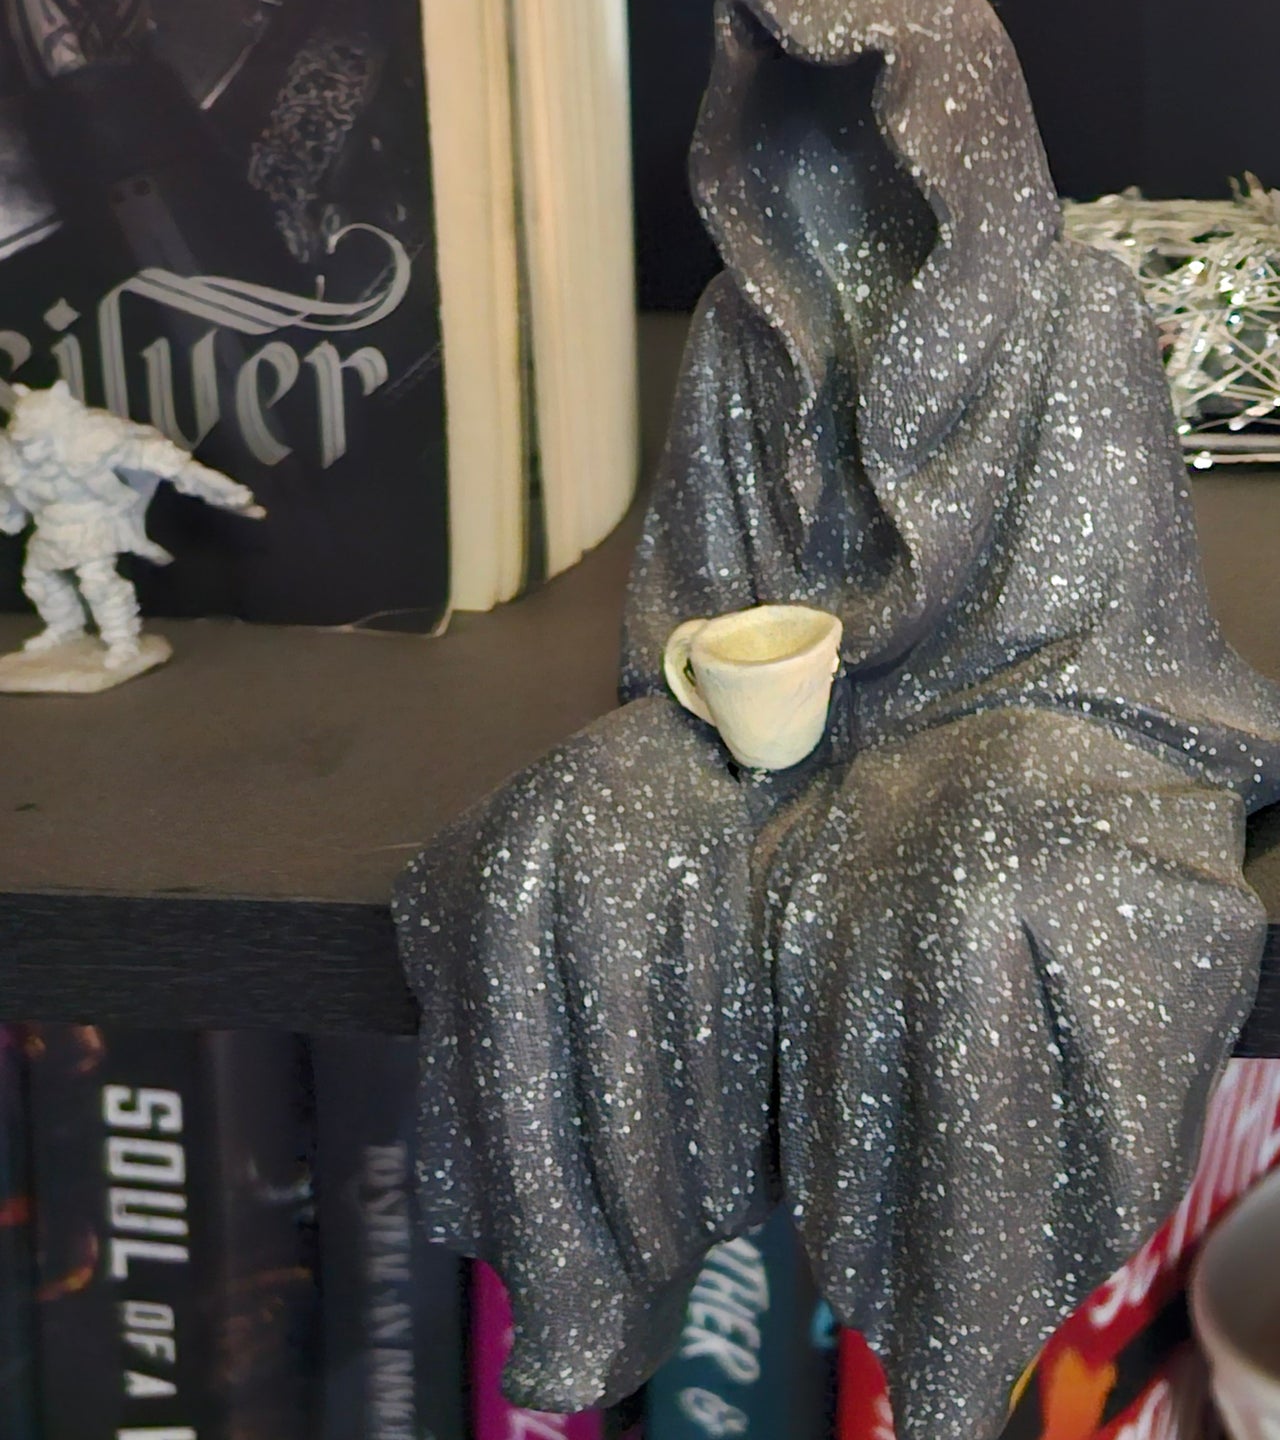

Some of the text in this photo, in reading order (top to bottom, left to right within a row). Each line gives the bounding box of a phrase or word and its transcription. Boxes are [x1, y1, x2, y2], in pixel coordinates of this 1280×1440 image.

[0, 222, 411, 469] ilver
[101, 1084, 190, 1281] SOUL
[120, 1300, 176, 1364] OF
[123, 1370, 178, 1398] A
